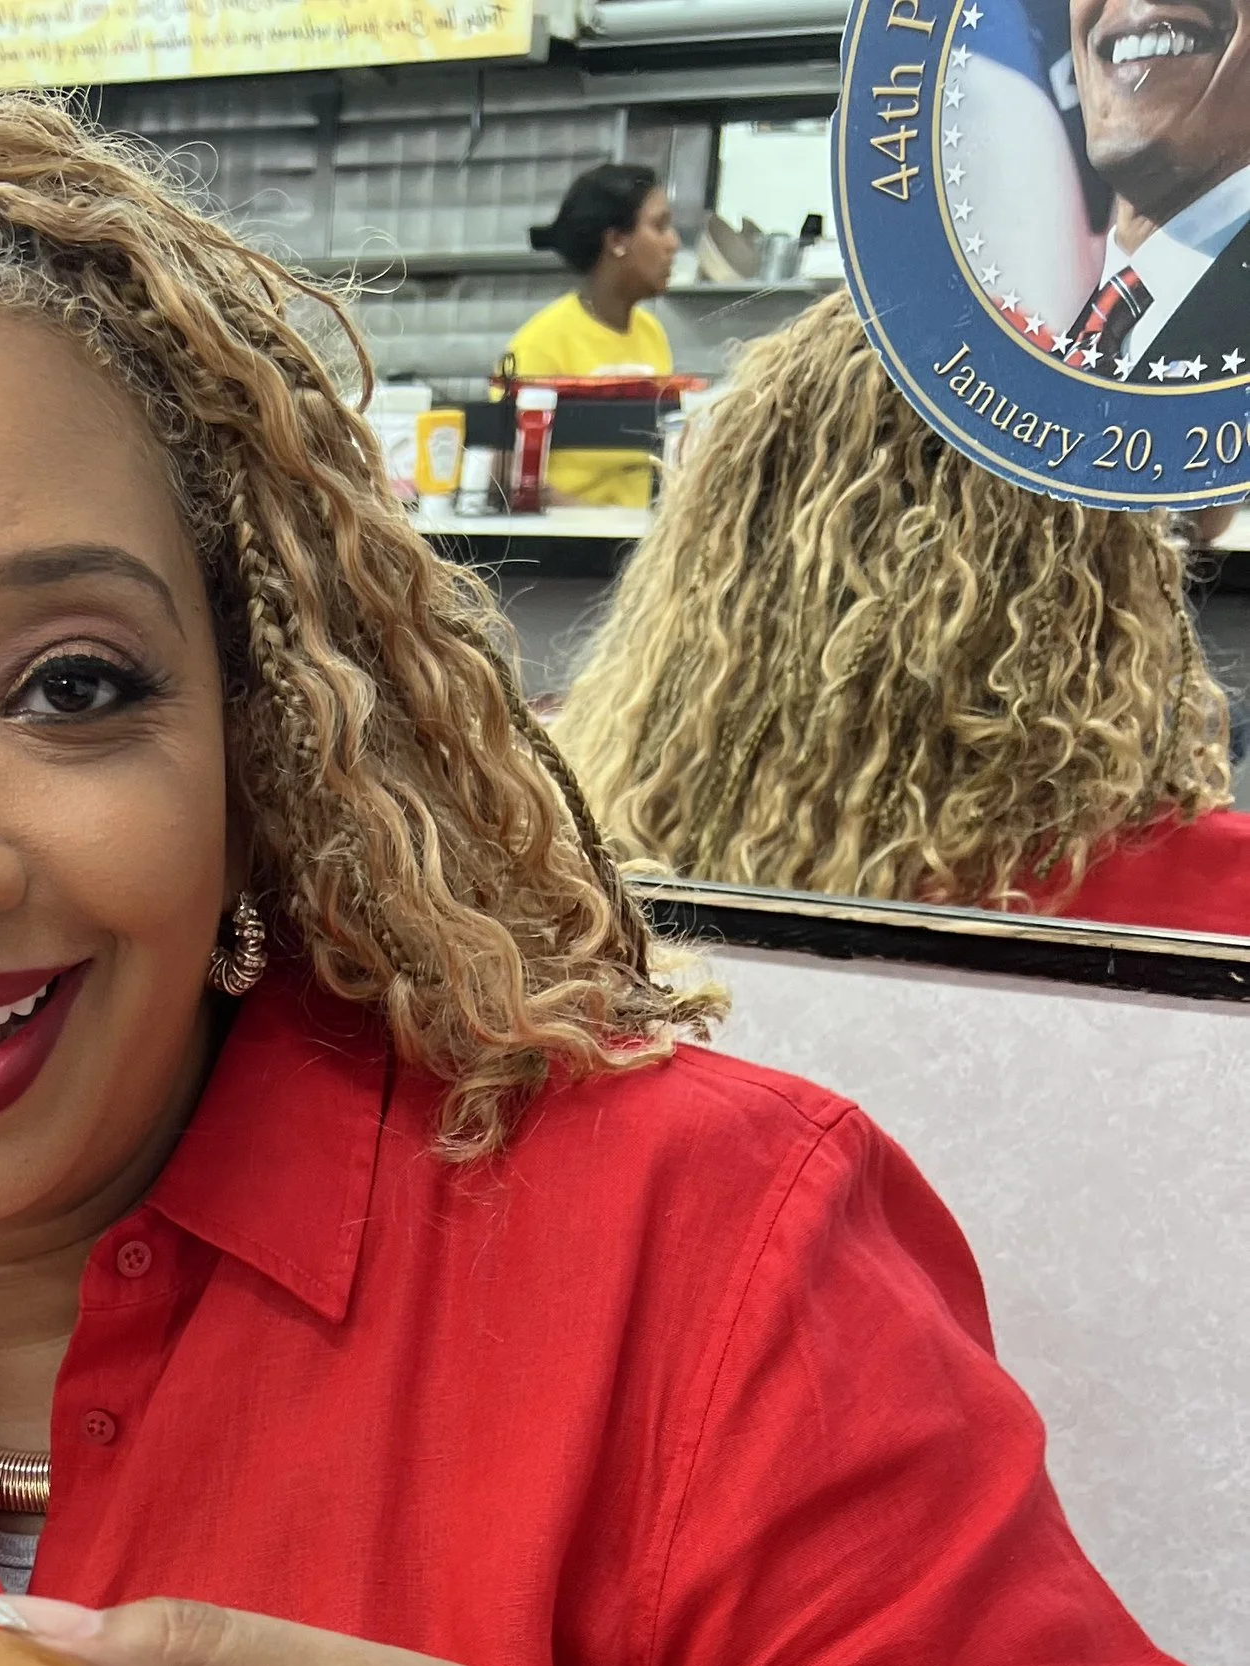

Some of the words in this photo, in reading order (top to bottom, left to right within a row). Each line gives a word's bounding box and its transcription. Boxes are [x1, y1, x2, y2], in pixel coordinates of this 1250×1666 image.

[870, 59, 926, 202] 44th
[933, 341, 1087, 468] January
[1093, 425, 1164, 481] 20,
[1183, 420, 1250, 471] 20
